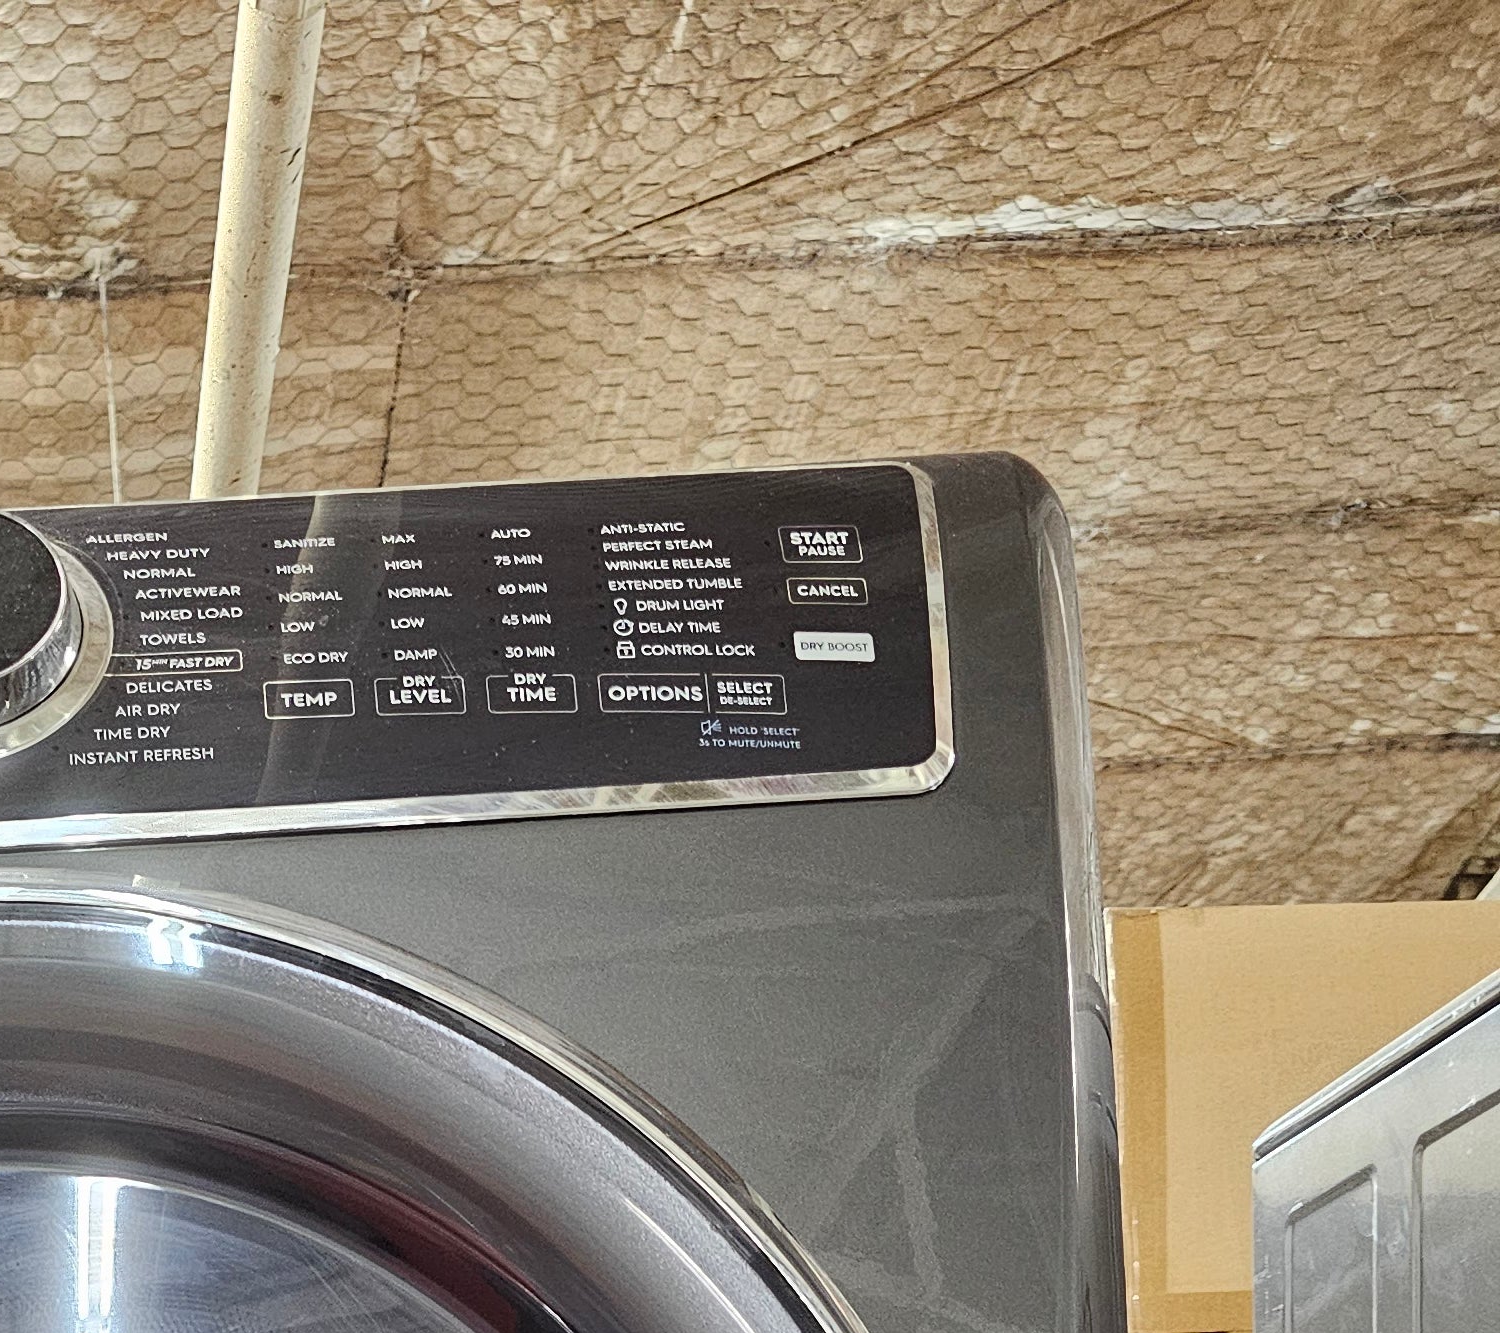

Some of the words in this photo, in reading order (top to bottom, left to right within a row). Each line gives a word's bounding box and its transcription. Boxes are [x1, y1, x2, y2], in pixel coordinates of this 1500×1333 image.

[491, 528, 531, 540] AUTO
[600, 521, 686, 535] ANTI-STATIC
[85, 532, 168, 544] ALLERGEN
[274, 537, 336, 549] SANITIZE
[381, 534, 416, 545] MAX
[790, 531, 849, 545] START
[602, 540, 662, 553] PERFECT
[665, 538, 713, 551] STEAM
[798, 545, 846, 556] PAUSE
[106, 550, 161, 561] HEAVY
[166, 547, 210, 559] DUTY
[494, 555, 511, 566] 75
[513, 553, 543, 565] MIN
[276, 563, 314, 575] HIGH
[384, 559, 423, 571] HIGH
[604, 559, 670, 572] WRINKLE
[672, 557, 732, 570] RELEASE
[123, 567, 196, 580] NORMAL
[497, 584, 516, 595] 60
[518, 582, 548, 594] MIN
[608, 579, 684, 592] EXTENDED
[686, 577, 743, 589] TUMBLE
[797, 585, 859, 597] CANCEL
[135, 585, 241, 600] ACTIVEWEAR
[278, 590, 343, 603] NORMAL
[387, 586, 453, 599] NORMAL
[635, 599, 680, 612] DRUM
[683, 598, 724, 611] LIGHT
[140, 609, 193, 622] MIXED
[197, 607, 243, 620] LOAD
[501, 614, 520, 626] 45
[522, 613, 552, 625] MIN
[280, 621, 315, 633] LOW
[390, 617, 425, 630] LOW
[638, 622, 684, 634] DELAY
[687, 621, 721, 633] TIME
[140, 632, 207, 646] TOWELS
[505, 646, 523, 658] 30
[526, 645, 556, 658] MIN
[640, 643, 713, 656] CONTROL
[715, 644, 756, 657] LOCK
[800, 641, 824, 650] DRY
[828, 642, 868, 652] BOOST
[283, 652, 315, 665] ECO
[318, 651, 349, 664] DRY
[394, 648, 438, 661] DAMP
[169, 657, 203, 669] FAST
[204, 656, 234, 668] DRY
[402, 675, 436, 688] DRY
[513, 673, 547, 685] DRY
[126, 678, 213, 694] DELICATES
[716, 681, 773, 694] SELECT
[281, 691, 338, 708] TEMP
[389, 688, 452, 705] LEVEL
[507, 686, 557, 702] TIME
[608, 685, 703, 702] OPTIONS
[720, 696, 773, 706] DE-SELECT
[115, 705, 142, 717] AIR
[147, 703, 181, 716] DRY
[93, 728, 133, 741] TIME
[137, 726, 171, 739] DRY
[729, 726, 758, 735] HOLD
[711, 739, 726, 747] TO
[728, 739, 801, 750] MUTE/UNMUTE
[69, 750, 138, 766] INSTANT
[143, 747, 214, 762] REFRESH
